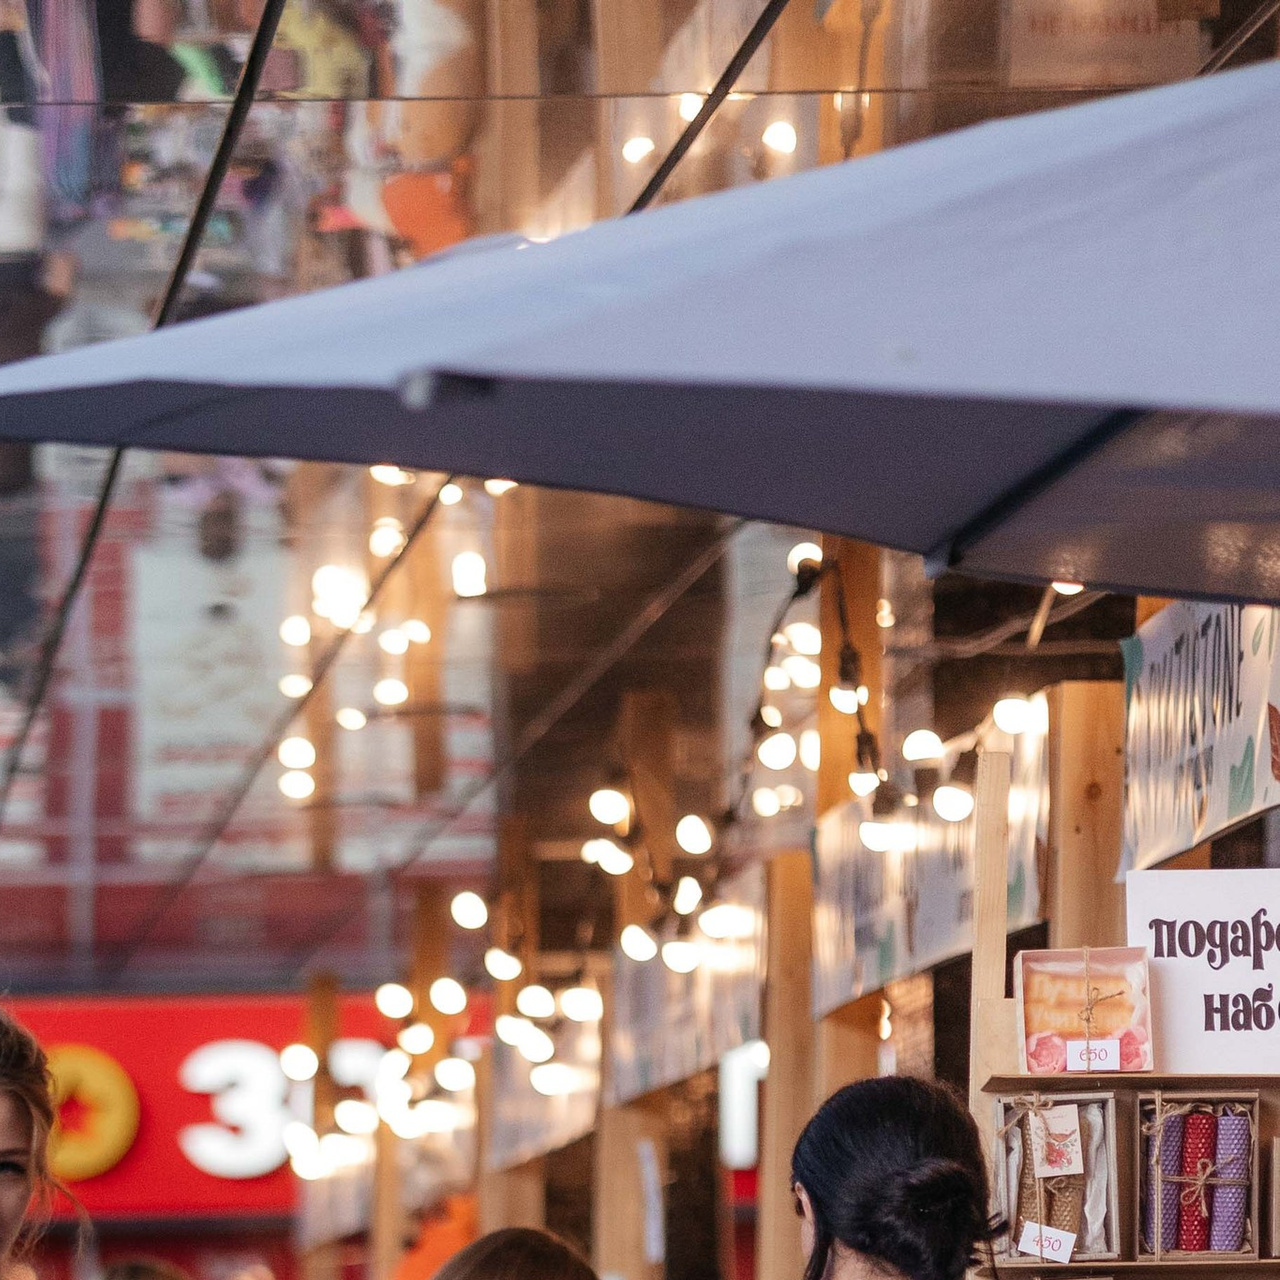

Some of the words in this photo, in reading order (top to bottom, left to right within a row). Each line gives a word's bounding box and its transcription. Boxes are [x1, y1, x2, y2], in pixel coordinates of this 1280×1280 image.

[1149, 908, 1280, 970] подар
[1204, 983, 1280, 1032] наб
[1079, 1047, 1109, 1062] 650
